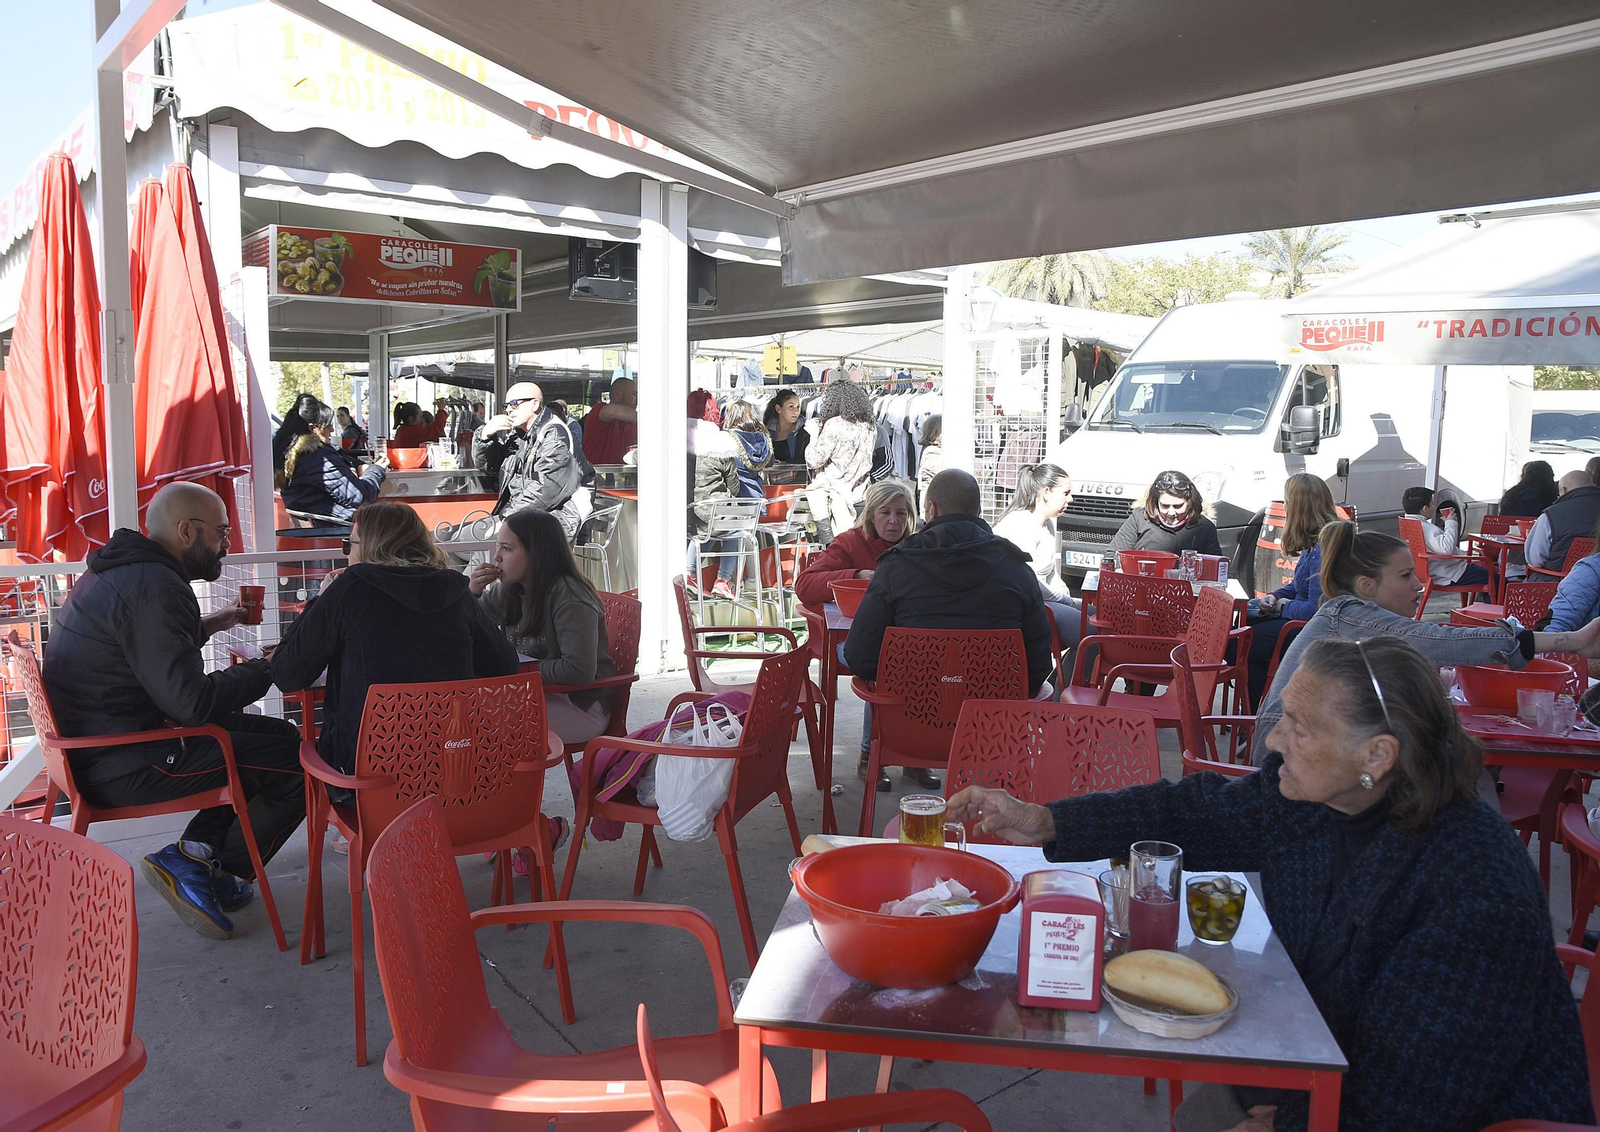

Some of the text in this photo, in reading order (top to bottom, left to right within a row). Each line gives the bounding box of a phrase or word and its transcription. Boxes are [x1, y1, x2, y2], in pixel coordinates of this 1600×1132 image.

[327, 73, 394, 113] 2014
[381, 238, 438, 250] CARACOLES
[418, 280, 437, 289] probar
[438, 280, 463, 290] nuestras
[1302, 318, 1367, 327] CARACOLES
[1080, 482, 1124, 495] IVECO
[1073, 553, 1096, 566] 5241
[444, 738, 473, 749] Coca-Cola
[1053, 942, 1080, 952] PREMIO
